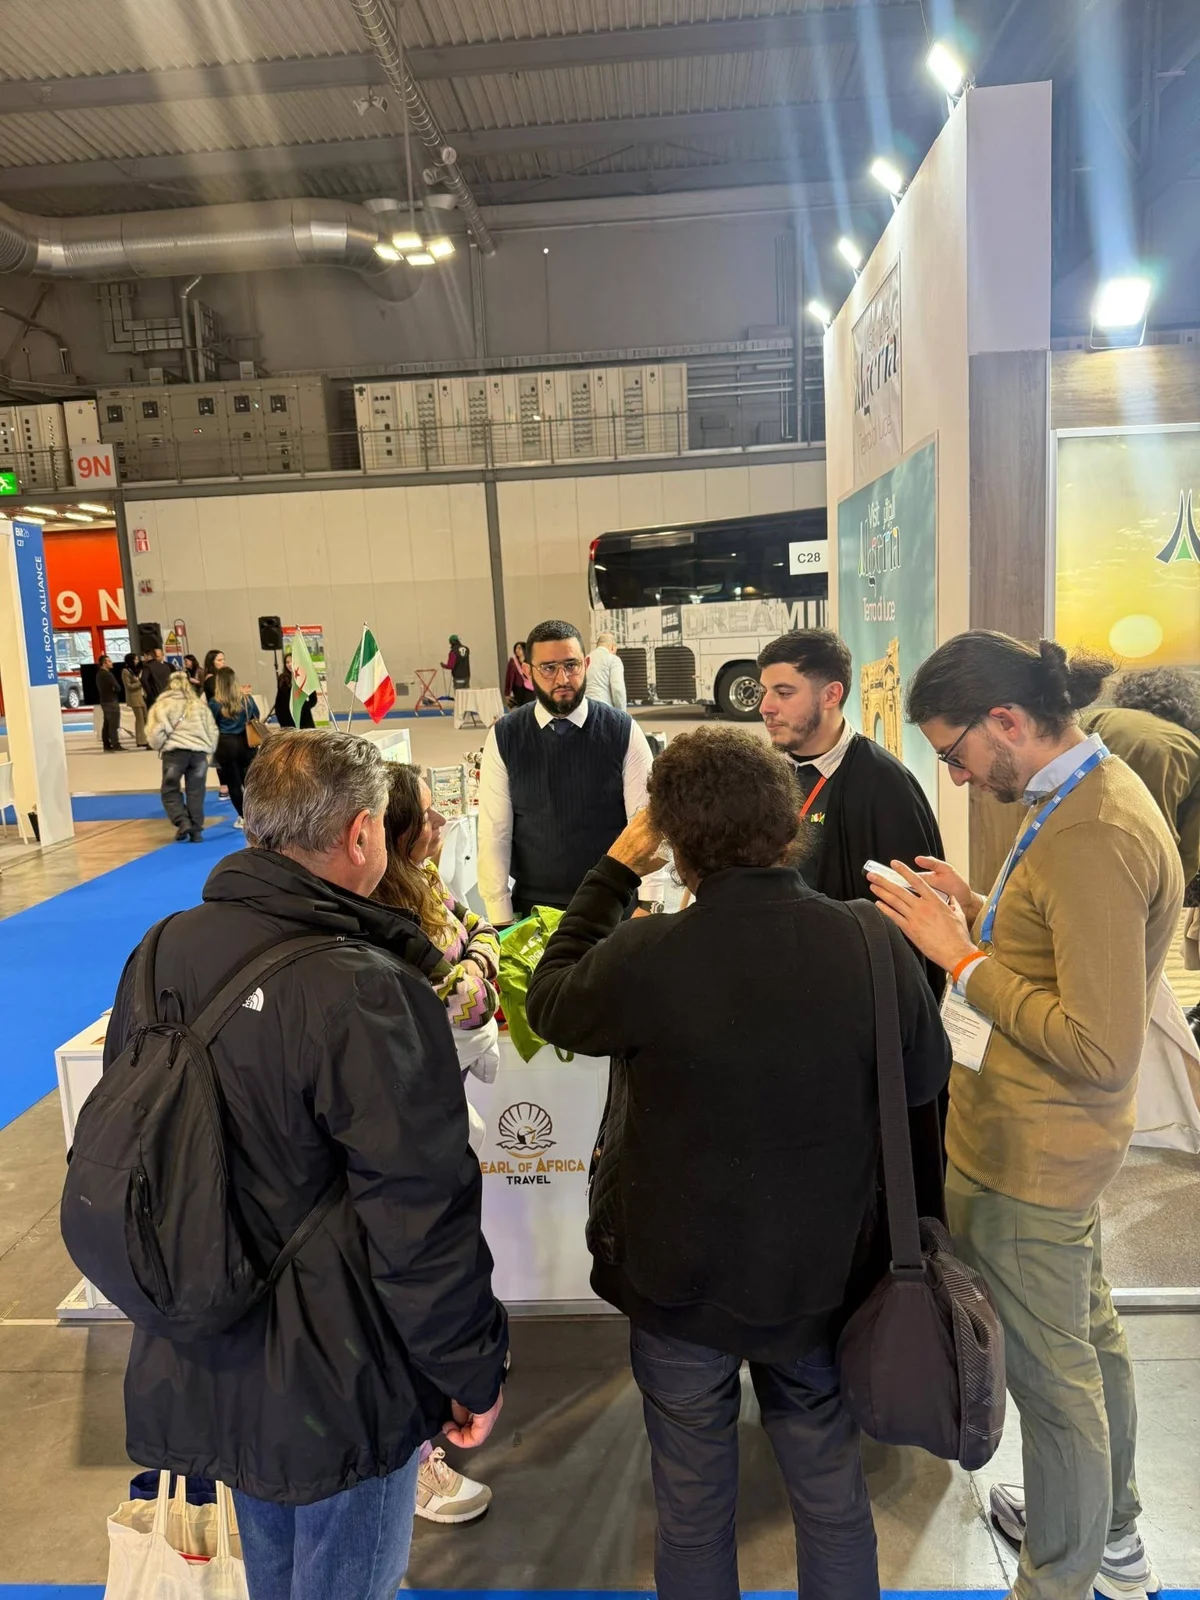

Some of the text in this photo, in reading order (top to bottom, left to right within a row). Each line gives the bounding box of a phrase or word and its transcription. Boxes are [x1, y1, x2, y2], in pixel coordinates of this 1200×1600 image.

[77, 455, 111, 478] 9N
[797, 552, 821, 564] C28
[858, 518, 901, 597] Algeria
[34, 555, 55, 680] SILK ROAD ALLIANCE
[56, 587, 127, 624] 9 N
[883, 595, 895, 621] luce
[480, 1157, 586, 1174] EARL OF AFRICA
[506, 1175, 551, 1185] TRAVEL
